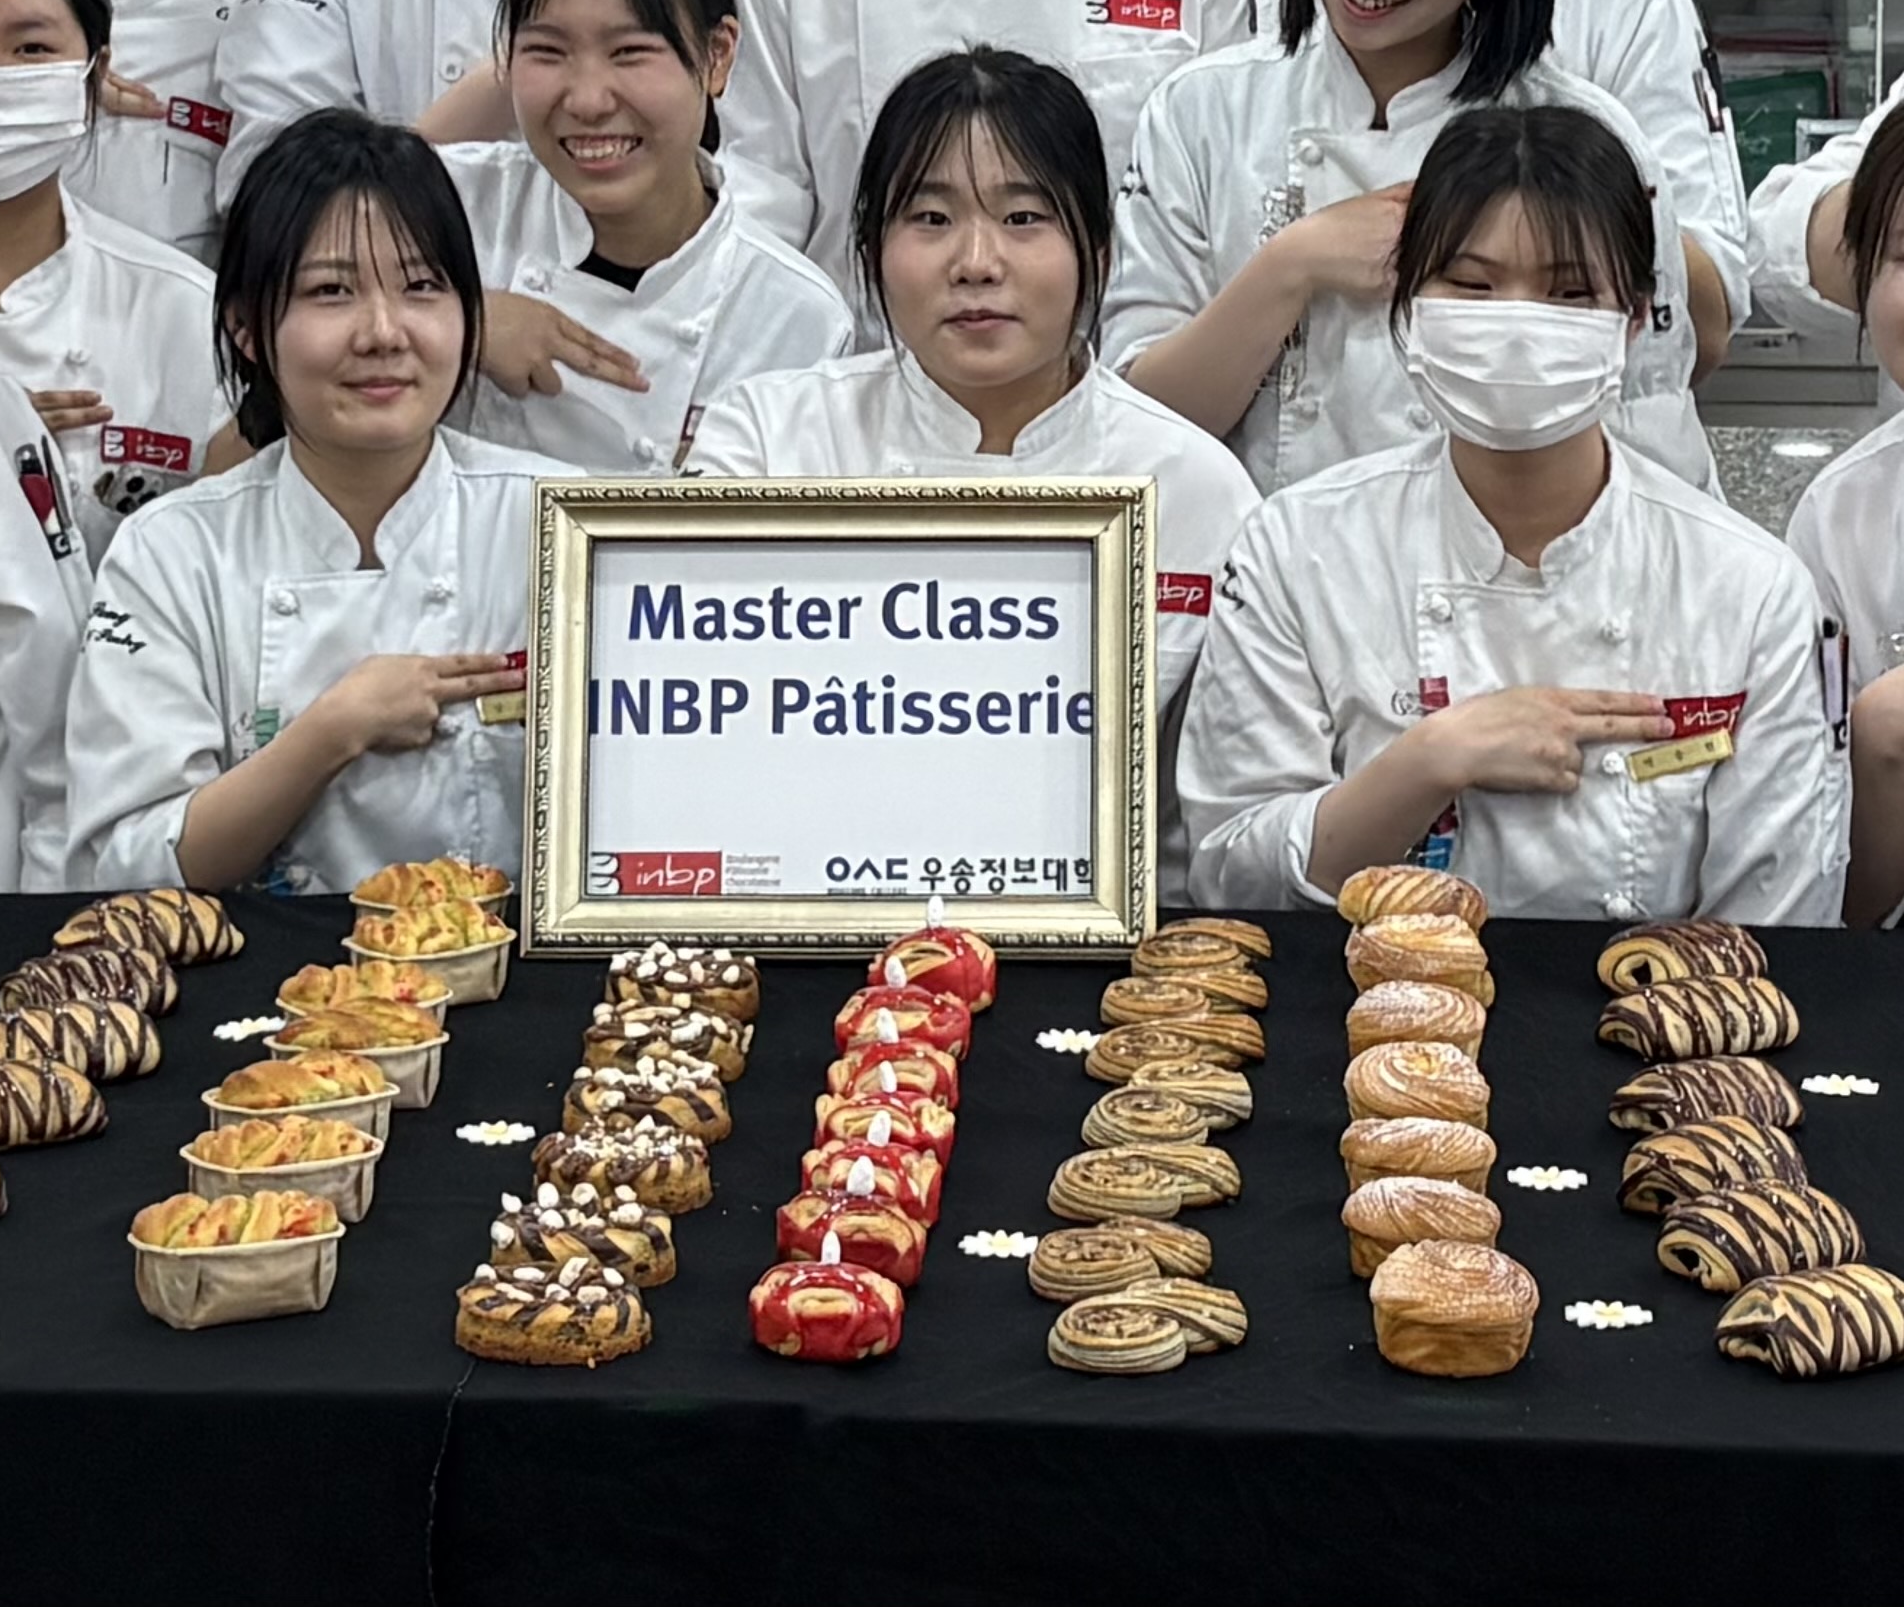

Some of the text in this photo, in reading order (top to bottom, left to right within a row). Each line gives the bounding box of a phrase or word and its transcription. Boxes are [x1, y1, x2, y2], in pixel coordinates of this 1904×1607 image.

[627, 580, 1060, 641] Master Class
[1156, 574, 1205, 610] bp
[589, 675, 1094, 736] INBP Pâtisserie
[636, 854, 717, 895] inbp
